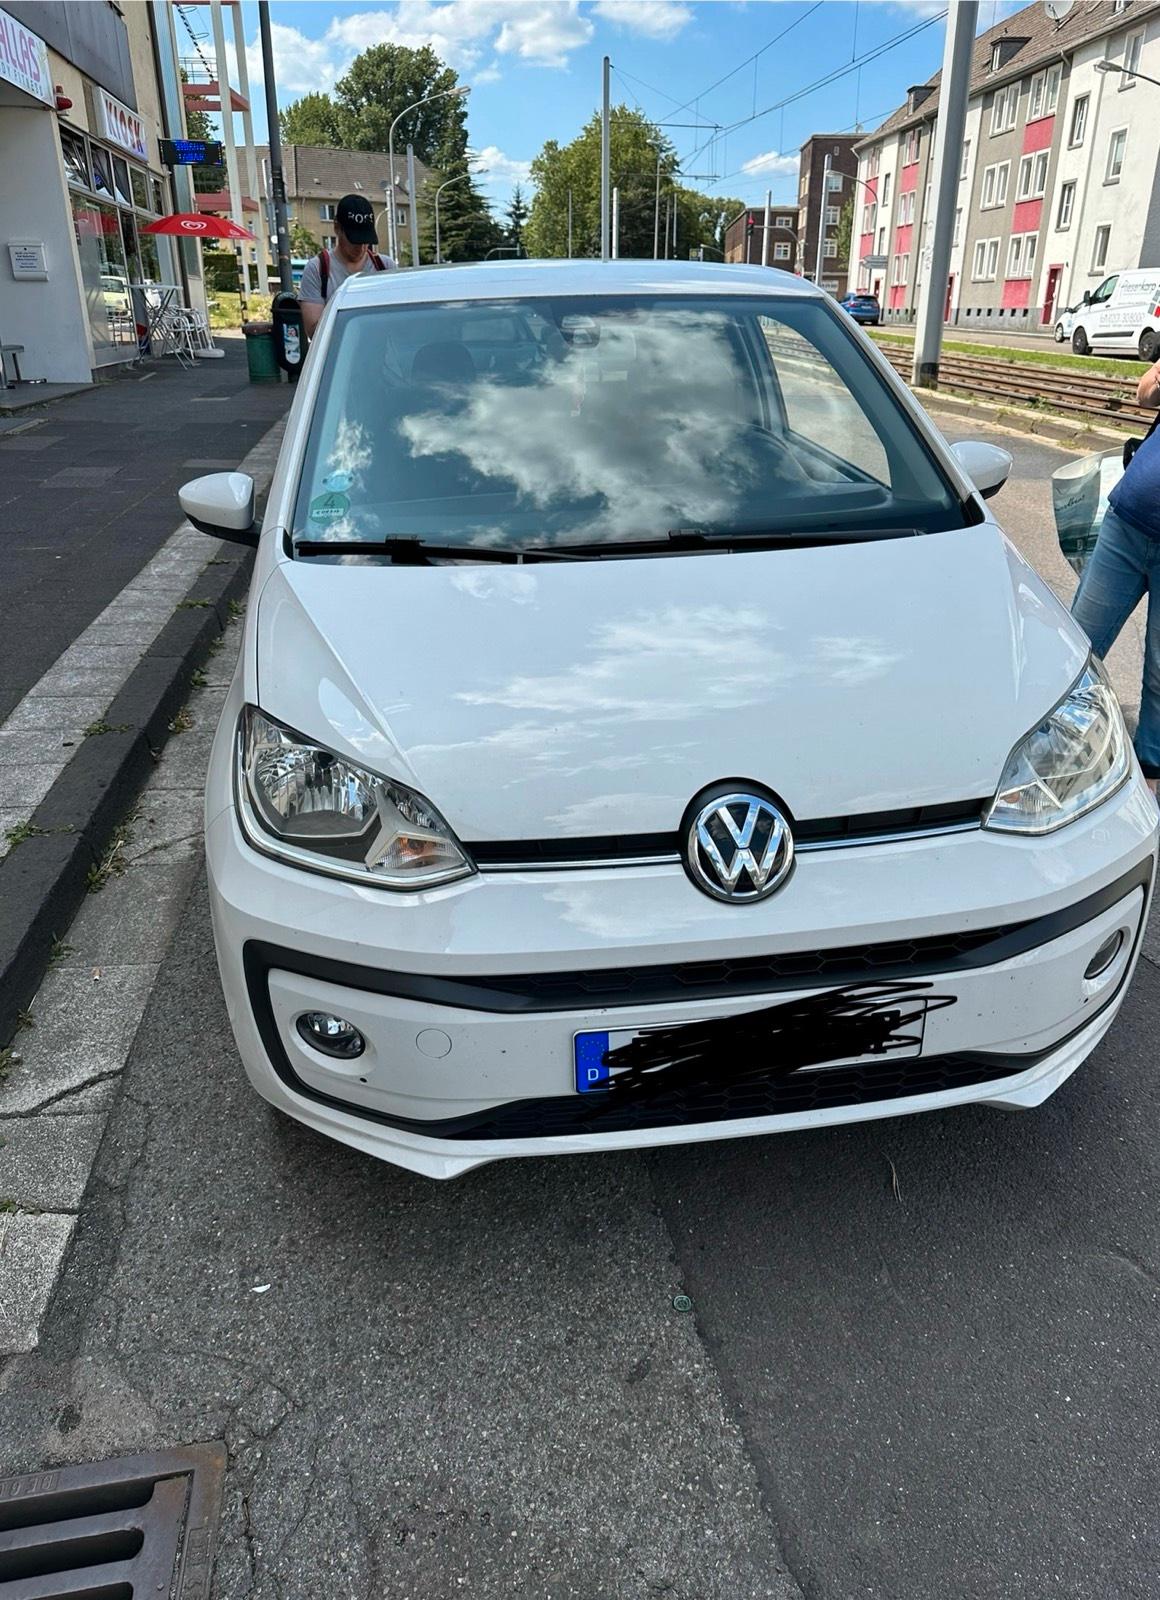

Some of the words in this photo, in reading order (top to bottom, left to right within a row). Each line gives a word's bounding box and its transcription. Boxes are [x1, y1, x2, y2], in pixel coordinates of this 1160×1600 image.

[105, 99, 144, 154] KIOSK
[696, 797, 786, 896] VW
[587, 1068, 599, 1081] D
